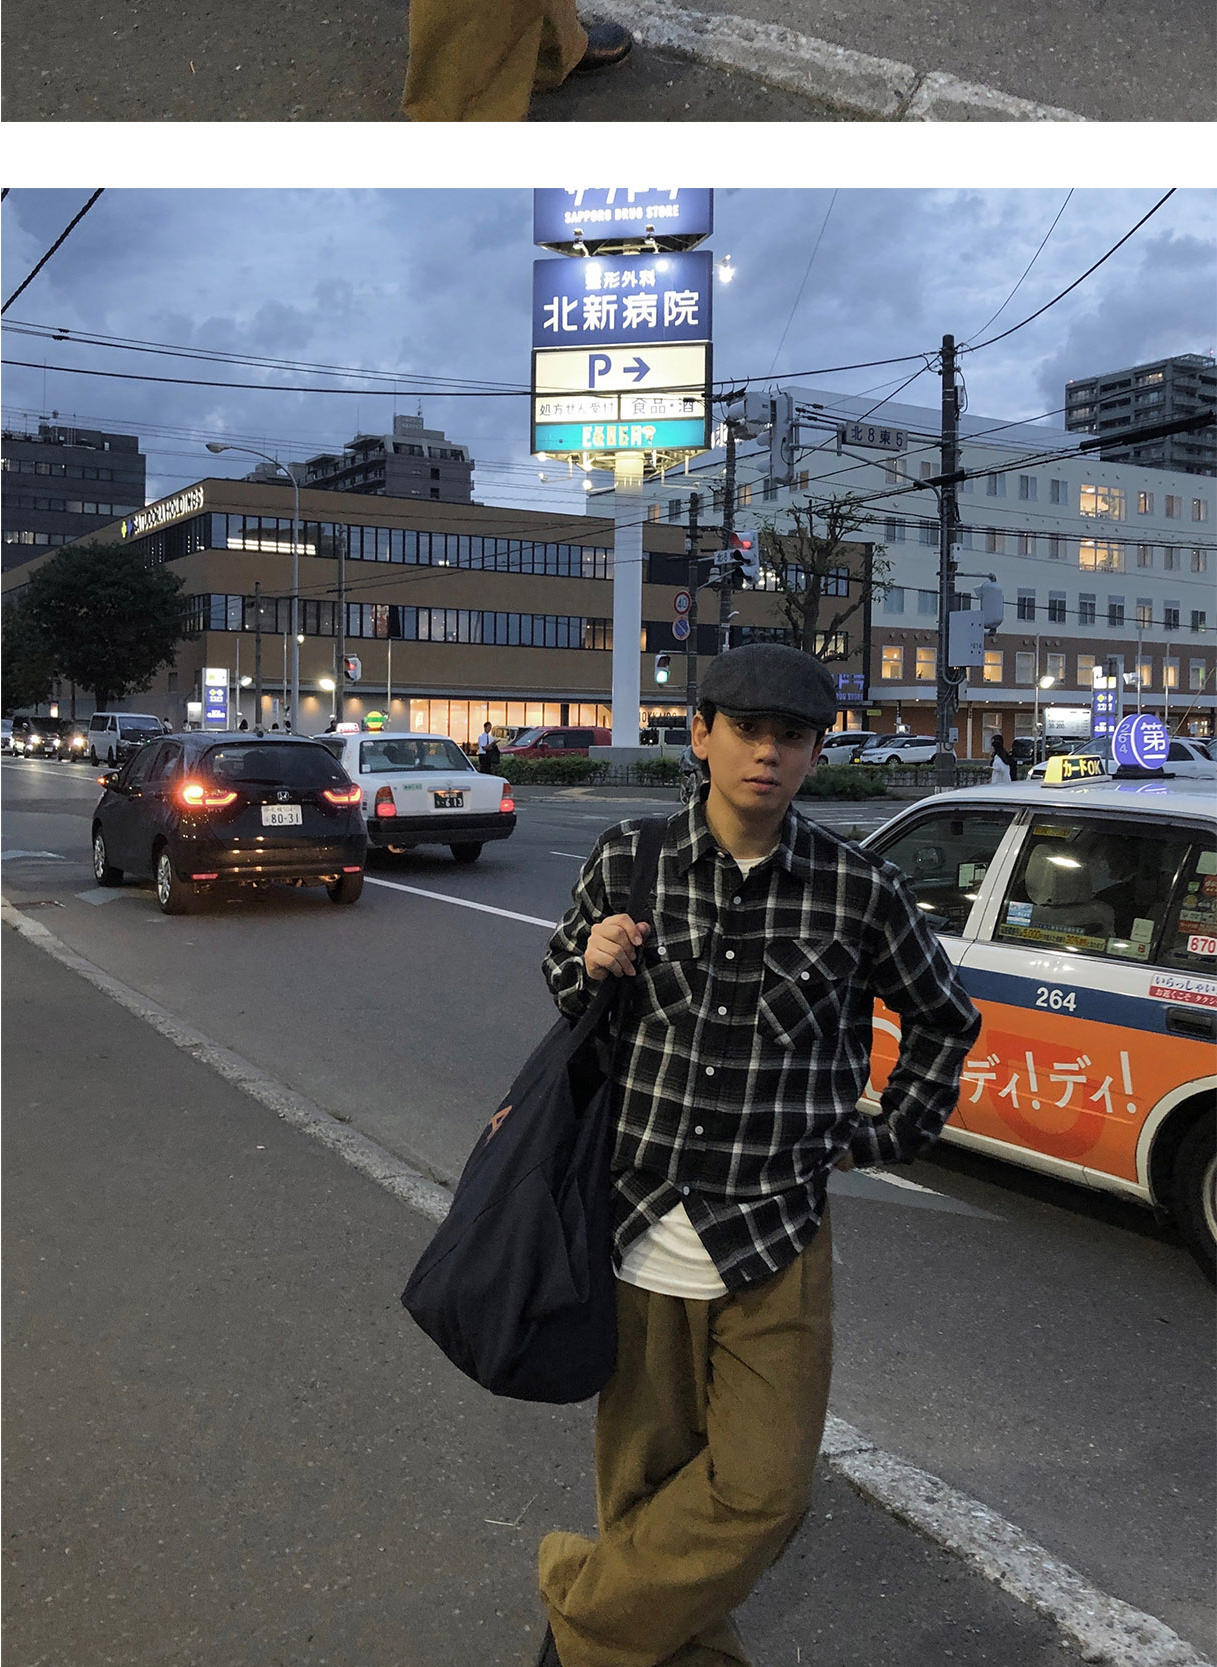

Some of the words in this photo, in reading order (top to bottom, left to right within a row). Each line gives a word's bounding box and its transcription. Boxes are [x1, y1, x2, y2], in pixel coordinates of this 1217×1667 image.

[564, 209, 611, 224] SAPPORO
[615, 207, 643, 220] DRUG
[646, 204, 679, 218] STORE
[543, 289, 699, 332] 北新病院
[588, 354, 612, 388] P
[1190, 937, 1216, 953] 670
[1036, 987, 1077, 1011] 264
